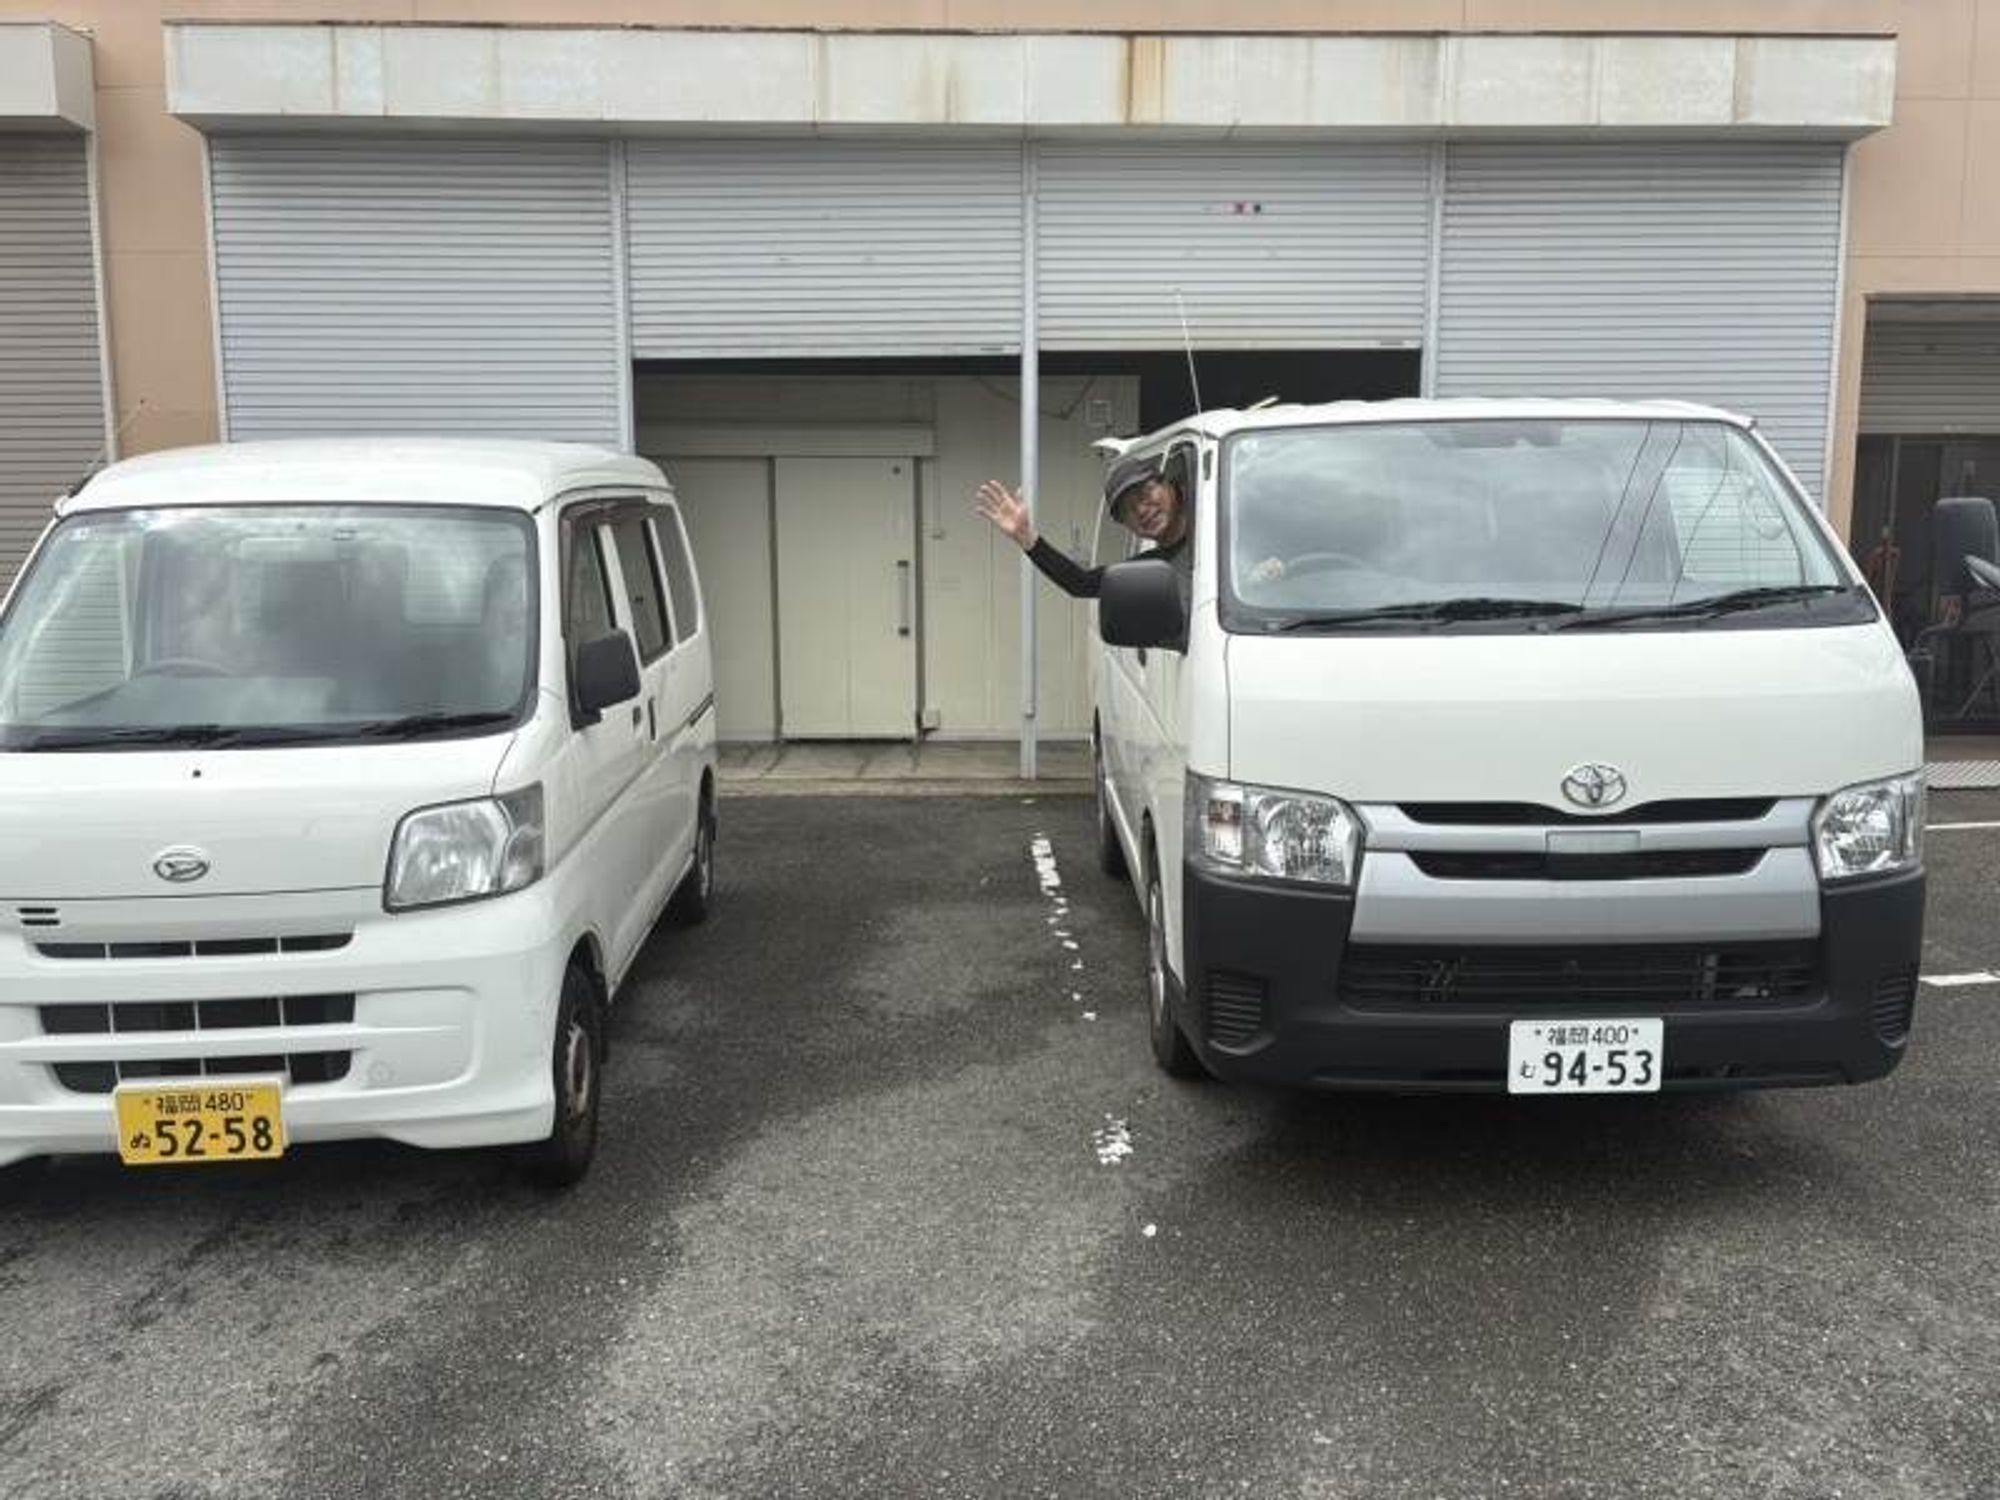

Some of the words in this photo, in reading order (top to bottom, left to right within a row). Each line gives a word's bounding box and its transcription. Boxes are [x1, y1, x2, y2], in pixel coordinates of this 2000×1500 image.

[1548, 1026, 1589, 1045] 福岡
[1592, 1025, 1629, 1044] 400
[1543, 1050, 1653, 1086] 94-53
[156, 1093, 201, 1114] 福岡
[205, 1092, 244, 1112] 480
[155, 1116, 273, 1156] 52-58
